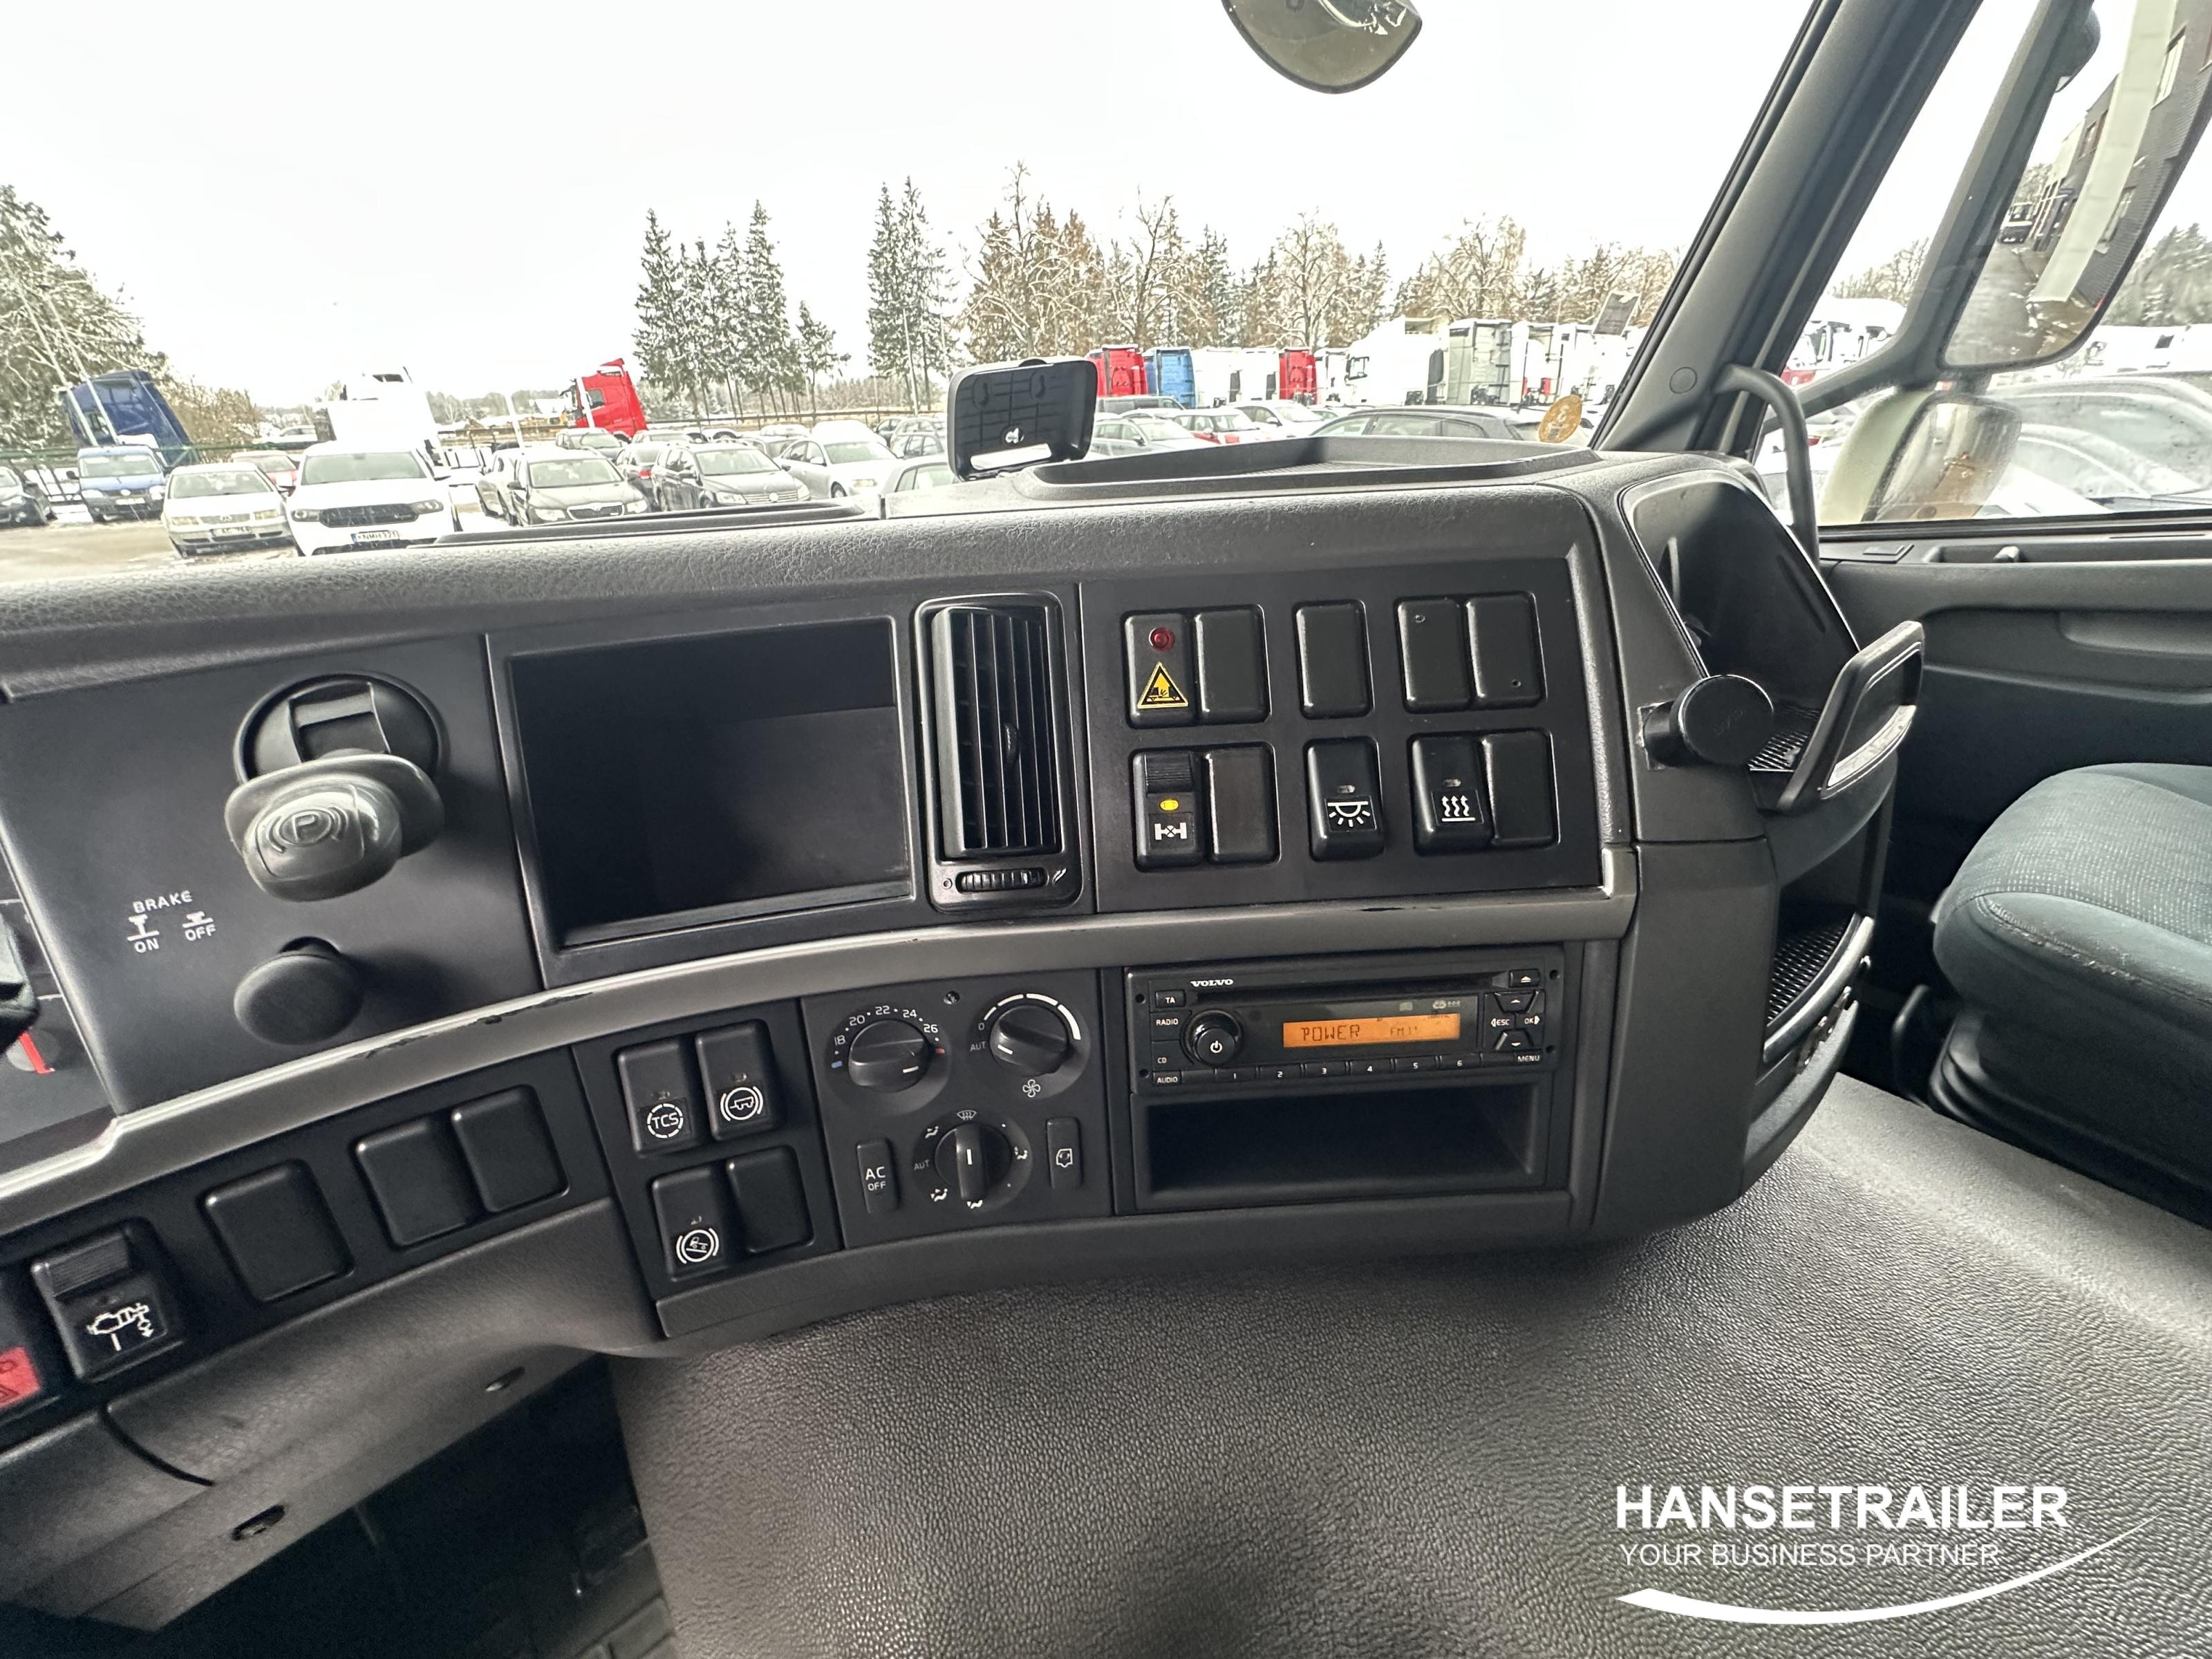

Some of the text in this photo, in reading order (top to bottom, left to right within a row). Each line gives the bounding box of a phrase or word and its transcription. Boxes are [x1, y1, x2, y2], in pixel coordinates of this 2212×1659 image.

[133, 890, 193, 914] BRAKE
[185, 924, 216, 942] OFF
[134, 938, 160, 954] ON
[1190, 978, 1234, 987] VOLVO
[834, 1005, 939, 1045] 18 20 22 24 26
[1301, 1024, 1360, 1042] POWER
[970, 1041, 986, 1051] AUT
[651, 1112, 679, 1129] TCS
[914, 1159, 930, 1171] AUT
[865, 1166, 886, 1181] AC
[868, 1181, 887, 1192] OFF
